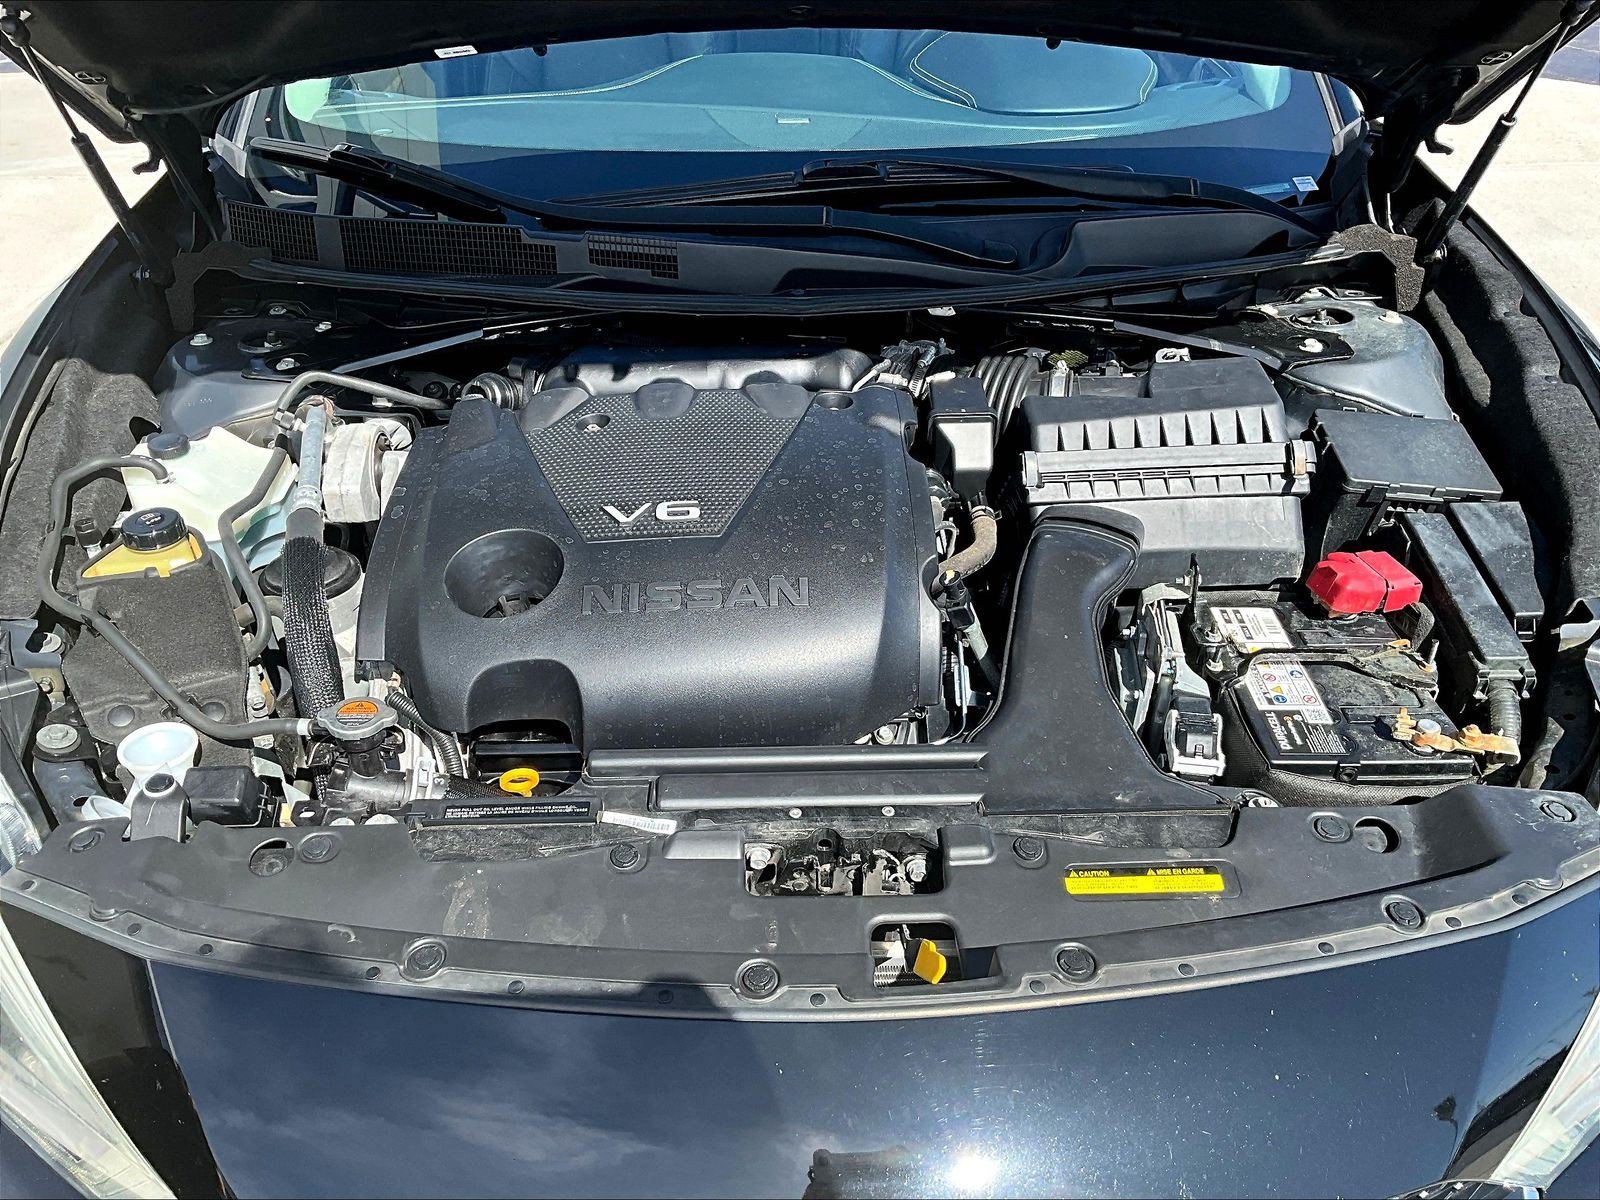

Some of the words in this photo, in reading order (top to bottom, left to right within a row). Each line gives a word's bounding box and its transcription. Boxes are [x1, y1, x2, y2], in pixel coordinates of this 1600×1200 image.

[602, 500, 701, 525] V6
[582, 574, 810, 615] NISSAN
[1182, 867, 1205, 875] GARDE
